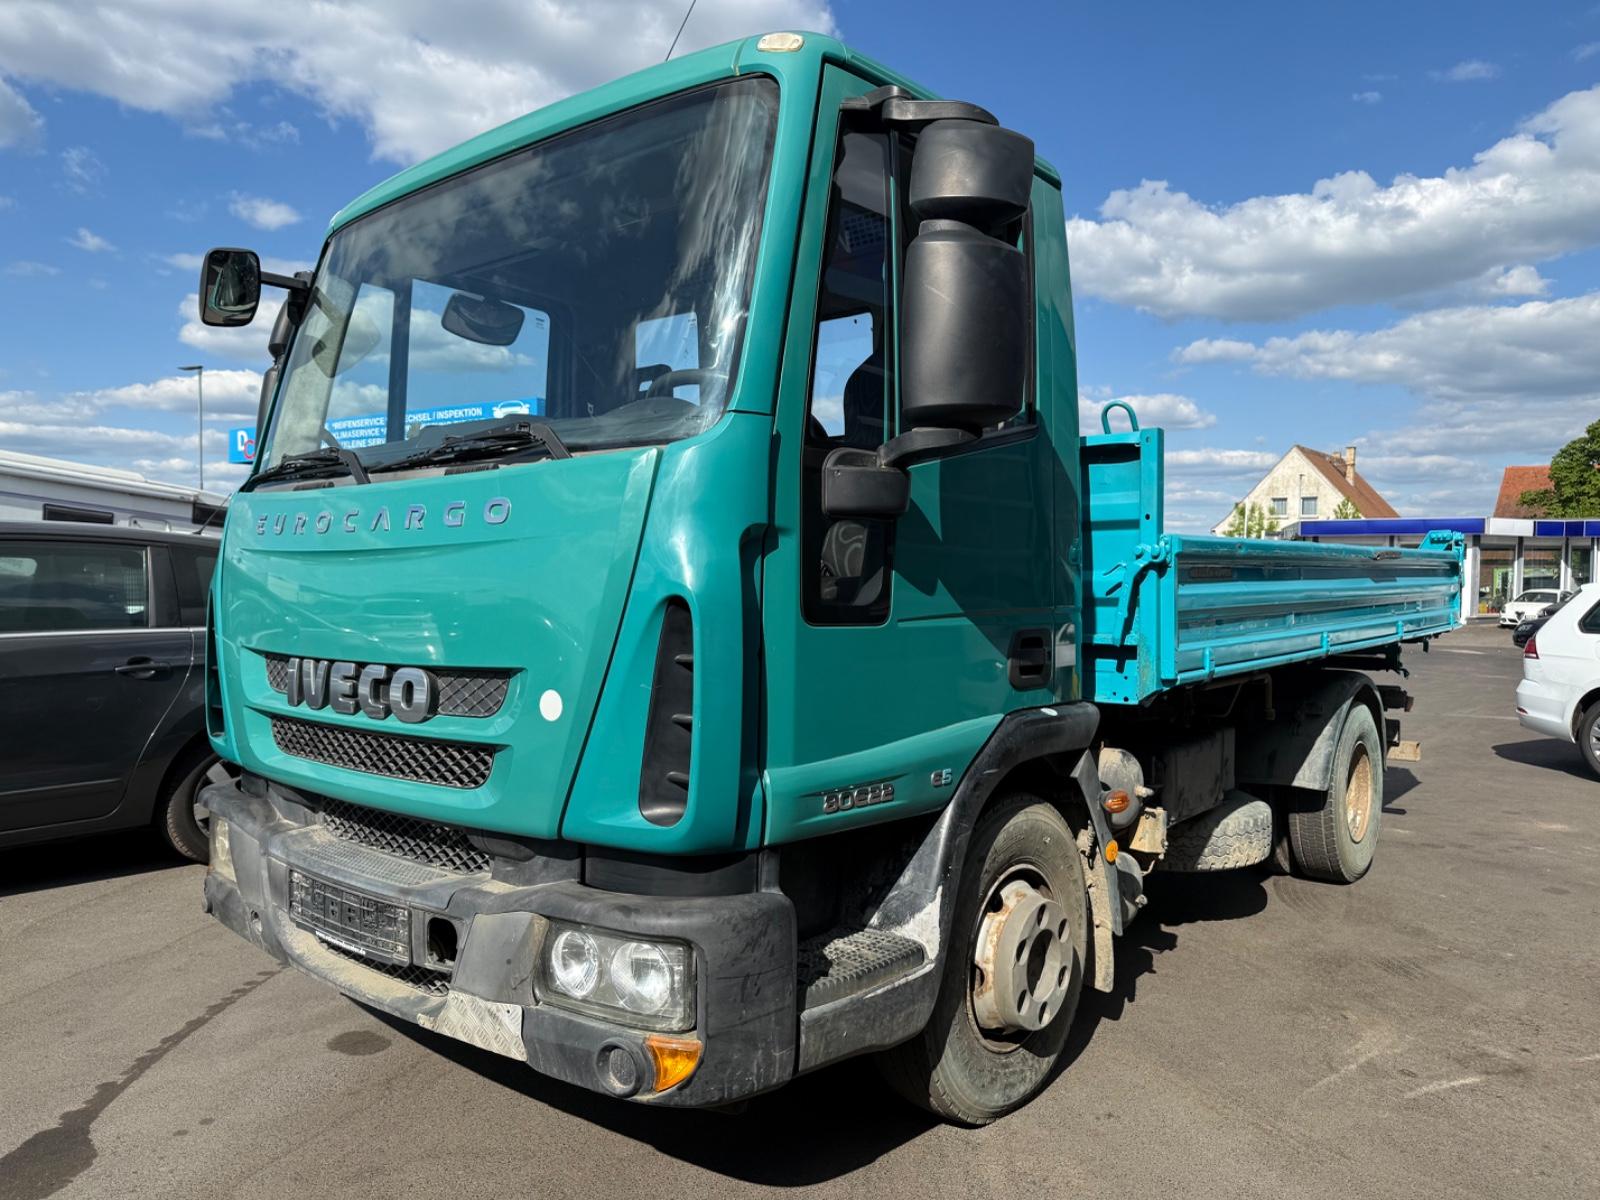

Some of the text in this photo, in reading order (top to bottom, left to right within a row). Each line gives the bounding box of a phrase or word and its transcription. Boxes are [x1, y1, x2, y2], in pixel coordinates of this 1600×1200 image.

[437, 407, 482, 419] INSPEKTION
[255, 496, 511, 535] EUROCARGO
[287, 657, 436, 723] IVECO
